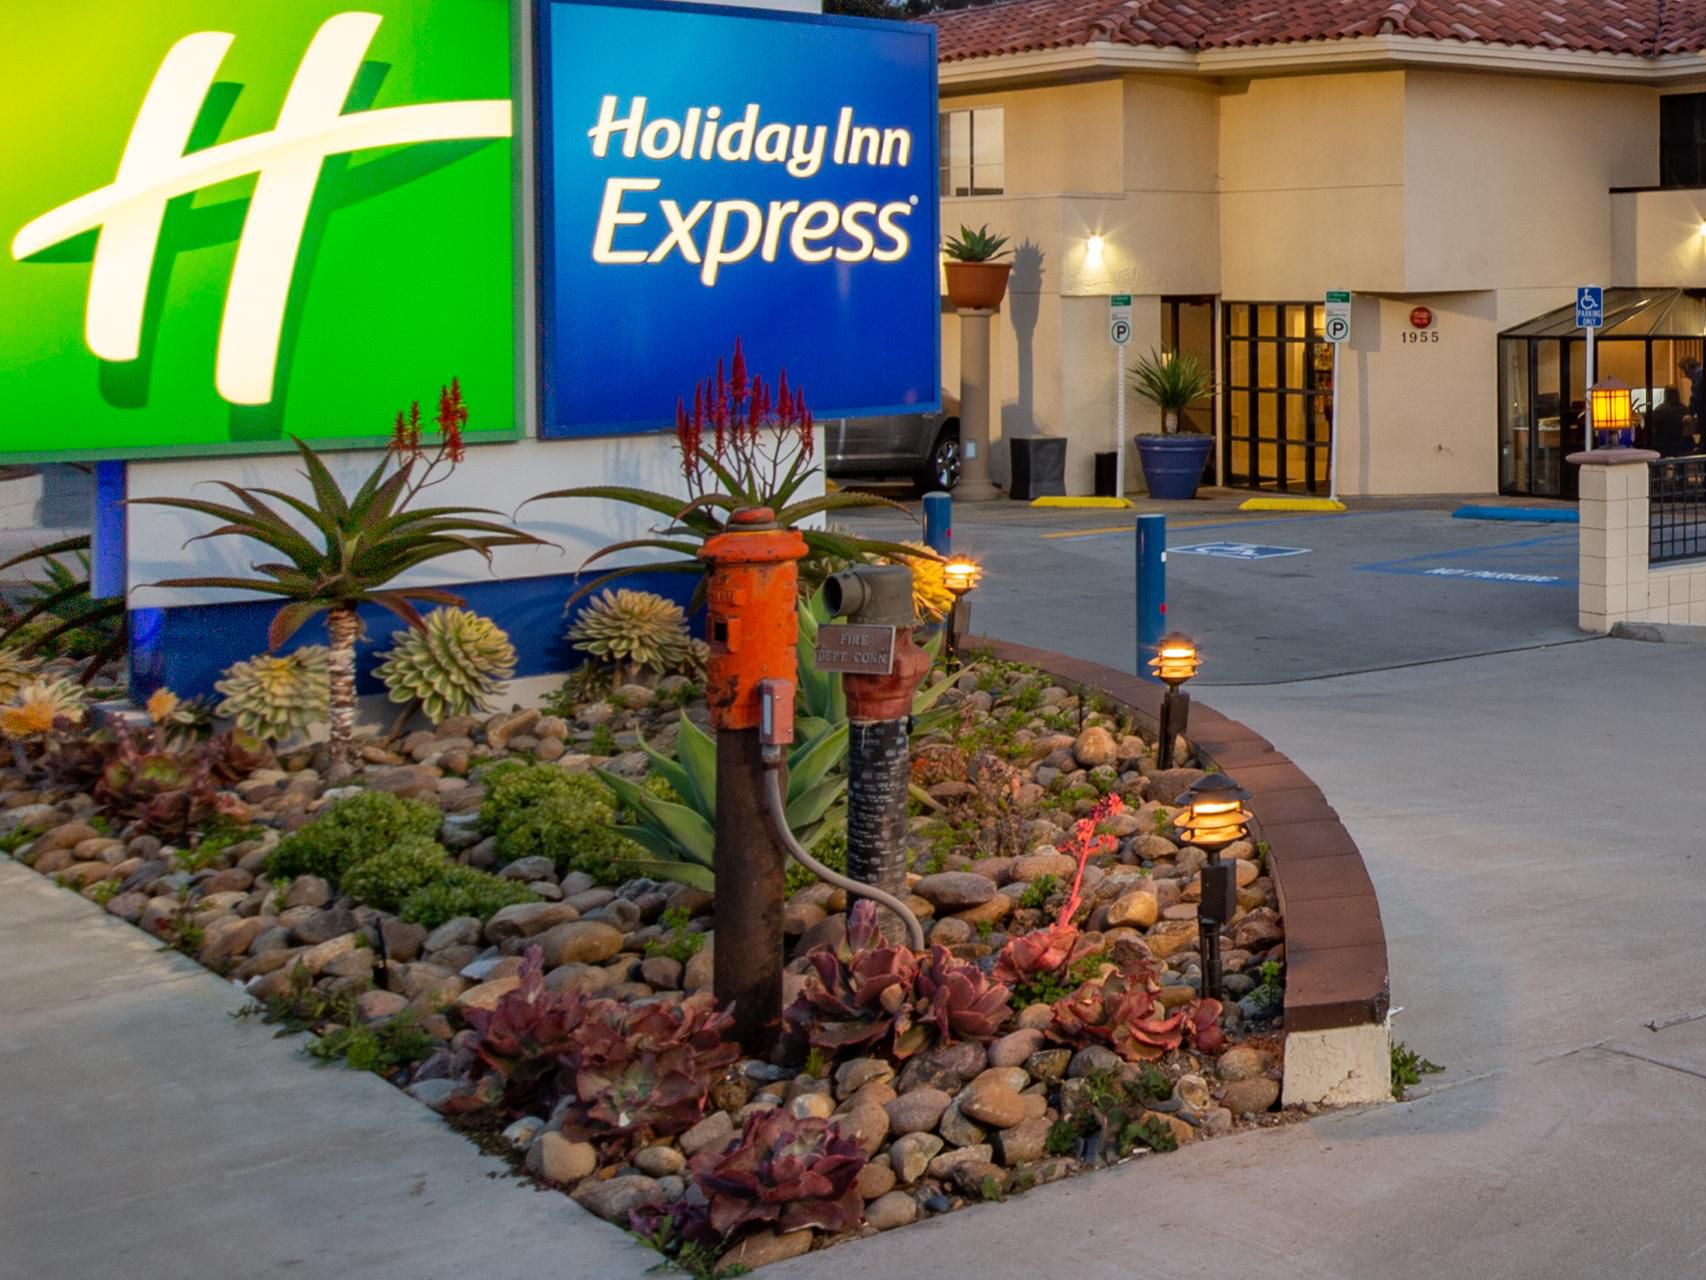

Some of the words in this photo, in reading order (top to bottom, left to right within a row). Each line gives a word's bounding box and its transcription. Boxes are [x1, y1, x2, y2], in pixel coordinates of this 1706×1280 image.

[588, 95, 828, 178] Holiday
[833, 106, 911, 167] Inn
[592, 177, 912, 286] Express
[1116, 325, 1126, 339] P
[1332, 322, 1344, 336] P
[1401, 331, 1439, 343] 1955
[840, 633, 869, 646] FIRE
